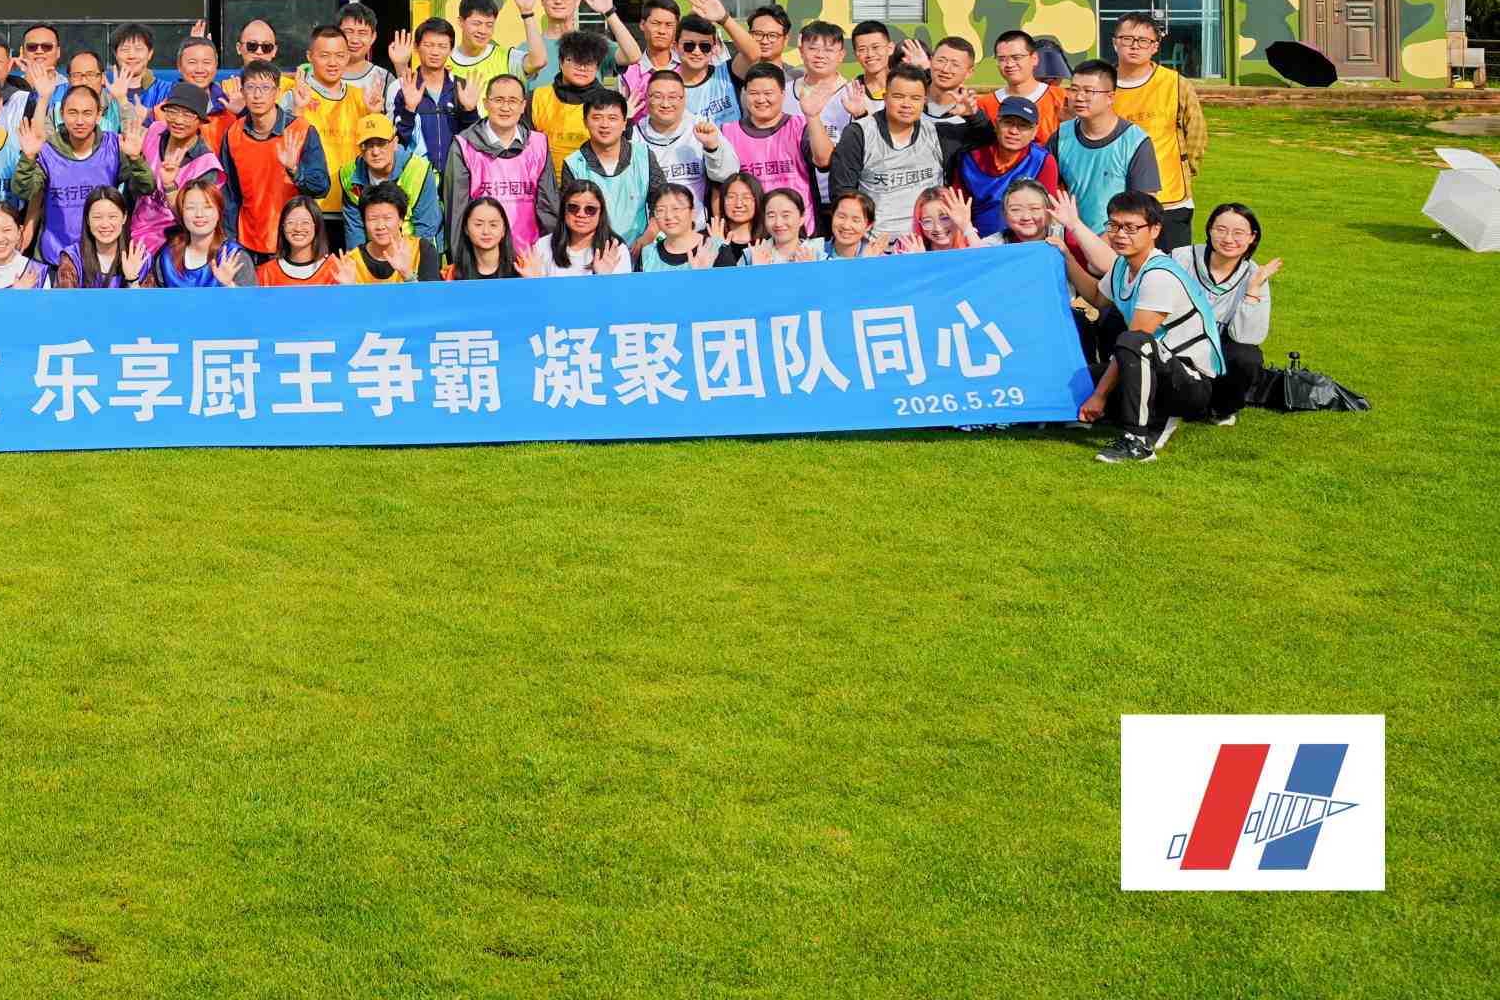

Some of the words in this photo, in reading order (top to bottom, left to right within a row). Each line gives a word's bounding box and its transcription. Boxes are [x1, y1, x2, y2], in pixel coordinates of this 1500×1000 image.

[661, 163, 701, 178] 行团建
[873, 168, 933, 187] 天行团建
[50, 185, 96, 200] 天行团
[479, 181, 533, 196] 天行团建
[30, 330, 501, 422] 乐享厨王争霸
[528, 300, 1014, 409] 凝聚团队同心
[893, 386, 1025, 417] 2026.5.29
